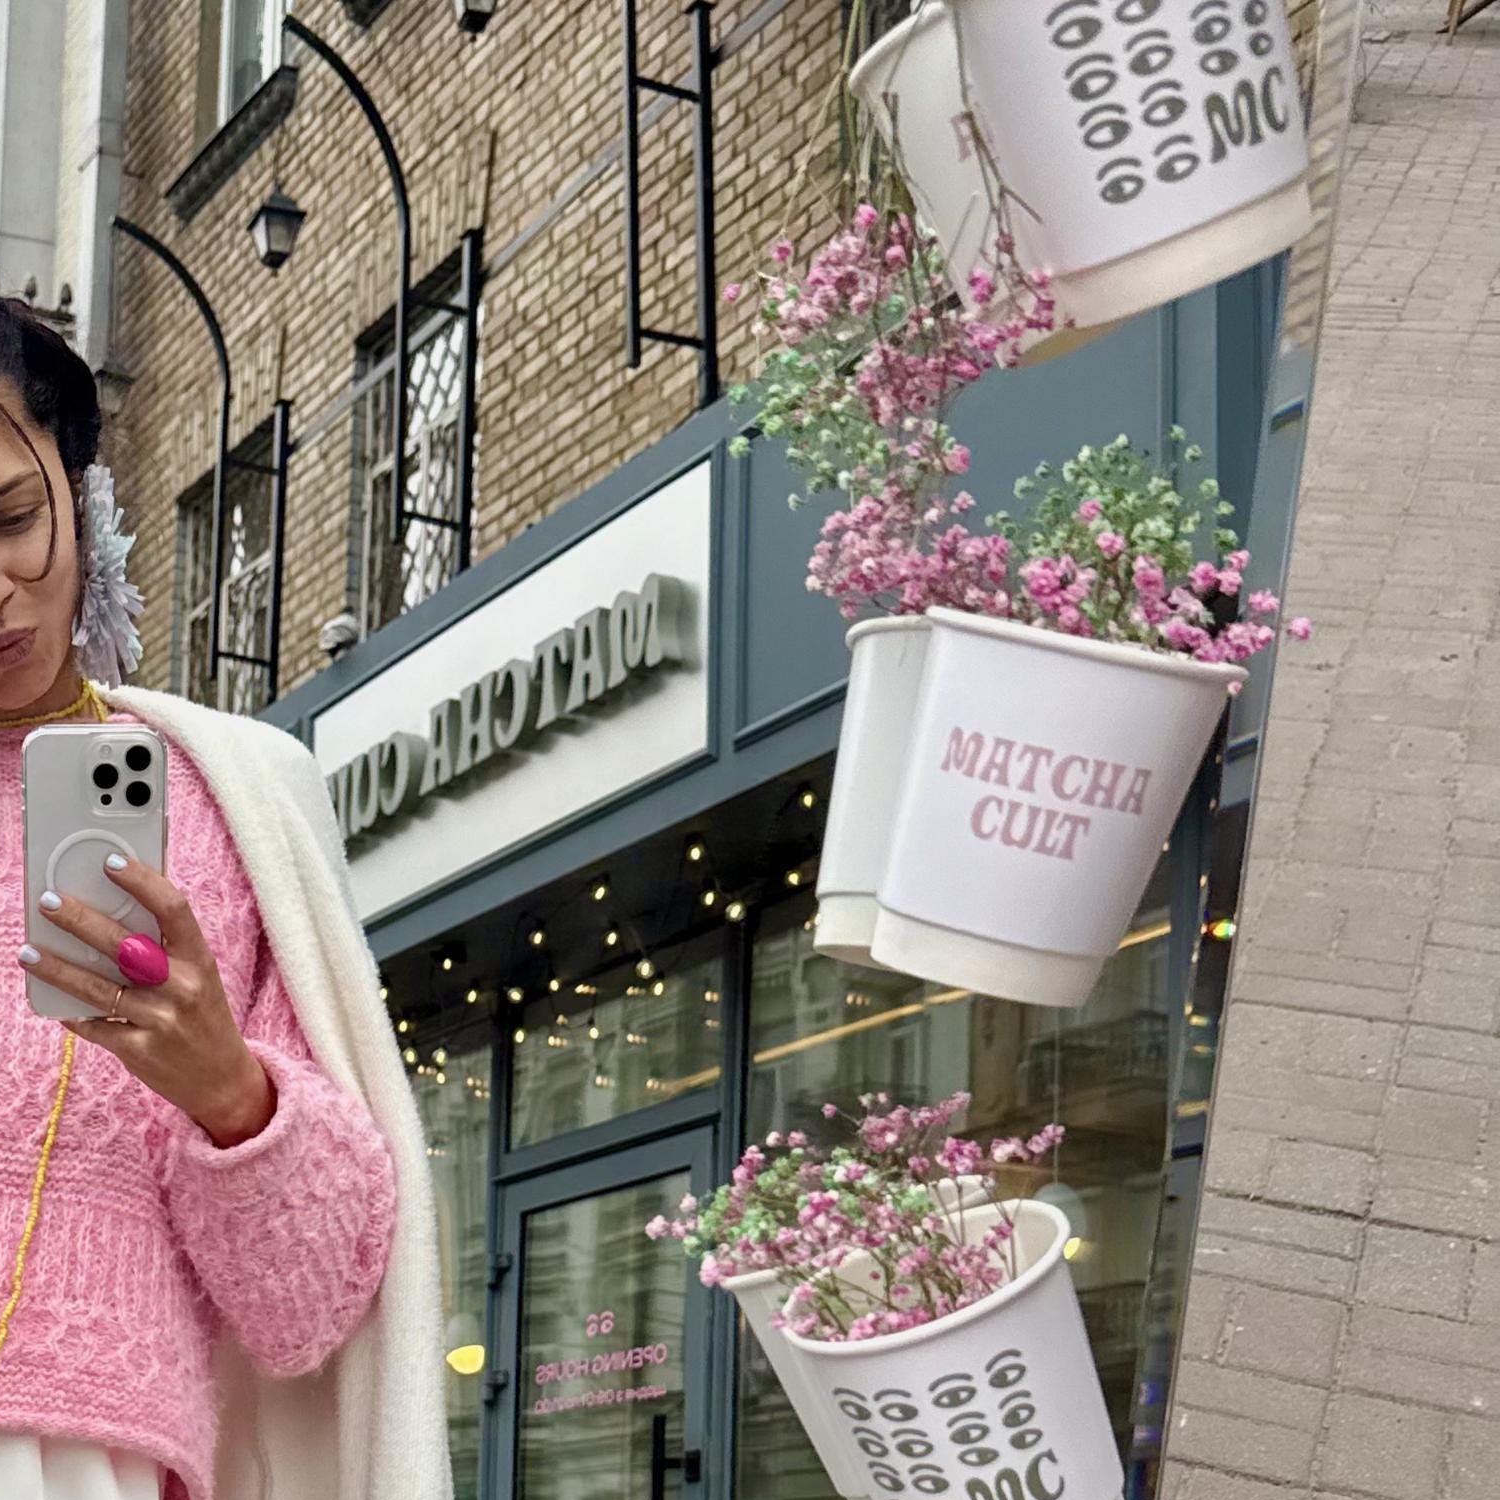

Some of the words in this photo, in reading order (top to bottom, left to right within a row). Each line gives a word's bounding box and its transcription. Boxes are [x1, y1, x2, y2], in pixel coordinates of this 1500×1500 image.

[1203, 66, 1290, 164] MC
[940, 726, 1153, 816] MATCHA
[970, 795, 1090, 861] CULT
